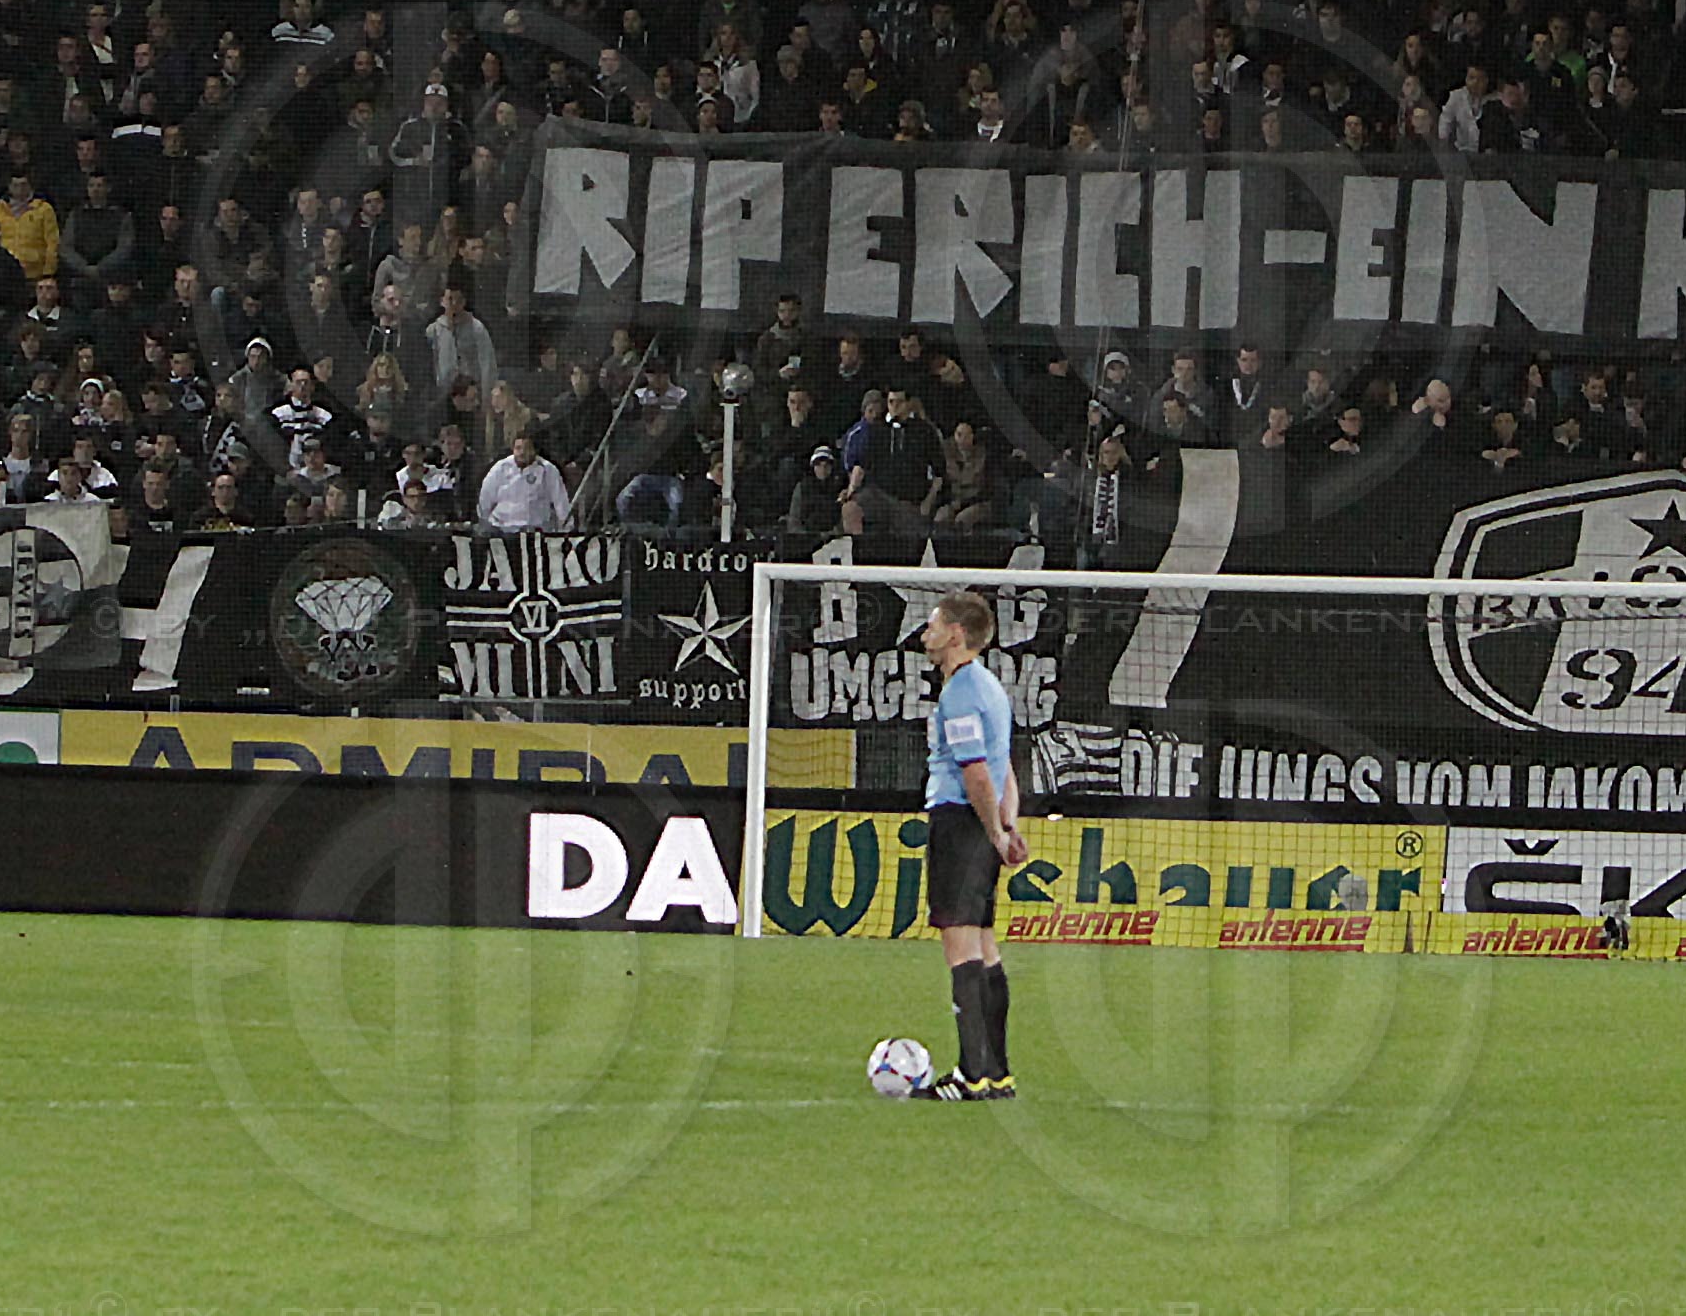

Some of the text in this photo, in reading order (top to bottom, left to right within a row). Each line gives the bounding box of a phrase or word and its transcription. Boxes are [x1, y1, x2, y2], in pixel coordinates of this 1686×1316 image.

[533, 146, 785, 311] RIP
[823, 164, 1599, 337] ERICH-EIN
[444, 535, 622, 591] JAKO
[643, 539, 777, 572] hardco
[520, 600, 550, 633] VI
[638, 678, 747, 710] support
[789, 647, 1060, 728] UMGENG
[1395, 758, 1513, 809] VOM
[528, 812, 739, 925] DA
[1006, 903, 1160, 939] antenne
[1219, 909, 1372, 943] antenne
